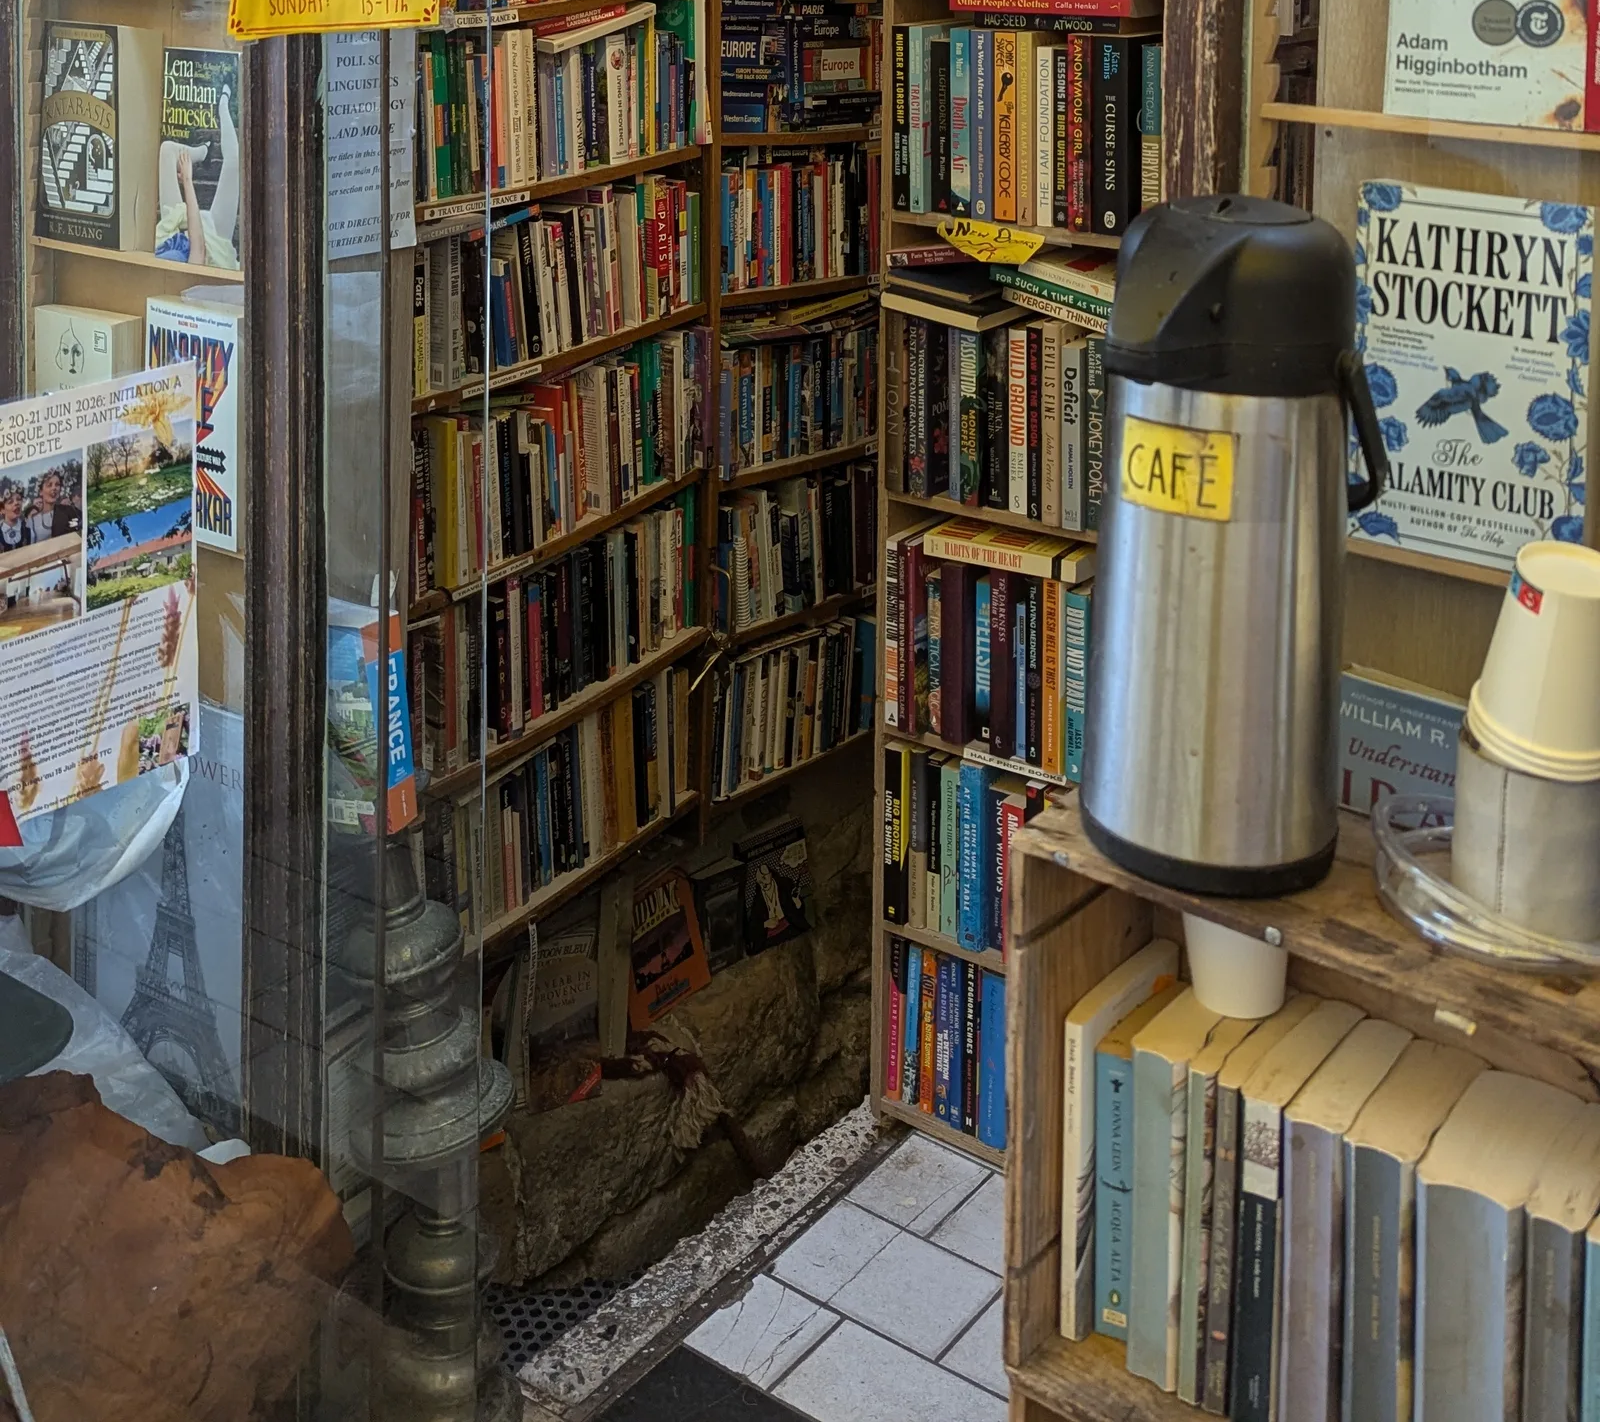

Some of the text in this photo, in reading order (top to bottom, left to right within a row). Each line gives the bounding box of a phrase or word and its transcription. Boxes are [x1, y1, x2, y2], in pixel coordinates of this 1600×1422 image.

[802, 4, 824, 15] PARIS
[984, 13, 1027, 27] HAG-SEED
[1053, 19, 1093, 31] ATWOOD
[721, 41, 756, 58] EUROPE
[1396, 33, 1448, 52] Adam
[164, 50, 194, 77] Lena
[822, 59, 855, 74] Europe
[1396, 54, 1528, 80] Higginbotham
[163, 79, 217, 105] Dunham
[43, 96, 113, 129] KATABASIS
[162, 99, 218, 129] Famesick
[67, 224, 103, 240] KUANG
[657, 211, 667, 262] PARIS
[1377, 217, 1567, 288] KATHRYN
[996, 272, 1074, 305] FOR SUCH A TIME
[1012, 292, 1062, 317] DIVERGENT
[1371, 270, 1567, 344] STOCKETT
[9, 379, 170, 429] 20-21 JUIN 2026: INITIATION
[1010, 339, 1026, 446] WILD GROUND
[1063, 367, 1079, 425] Deficit
[48, 407, 130, 436] DES PLANTES
[1432, 439, 1483, 468] The
[1128, 444, 1219, 509] CAFÉ
[1492, 481, 1554, 520] CLUB
[944, 542, 1022, 568] HABITS OF THE HEART
[970, 751, 1063, 782] HALF PRICE BOOKS
[884, 823, 892, 865] SHRIVER
[892, 815, 900, 862] BROTHER
